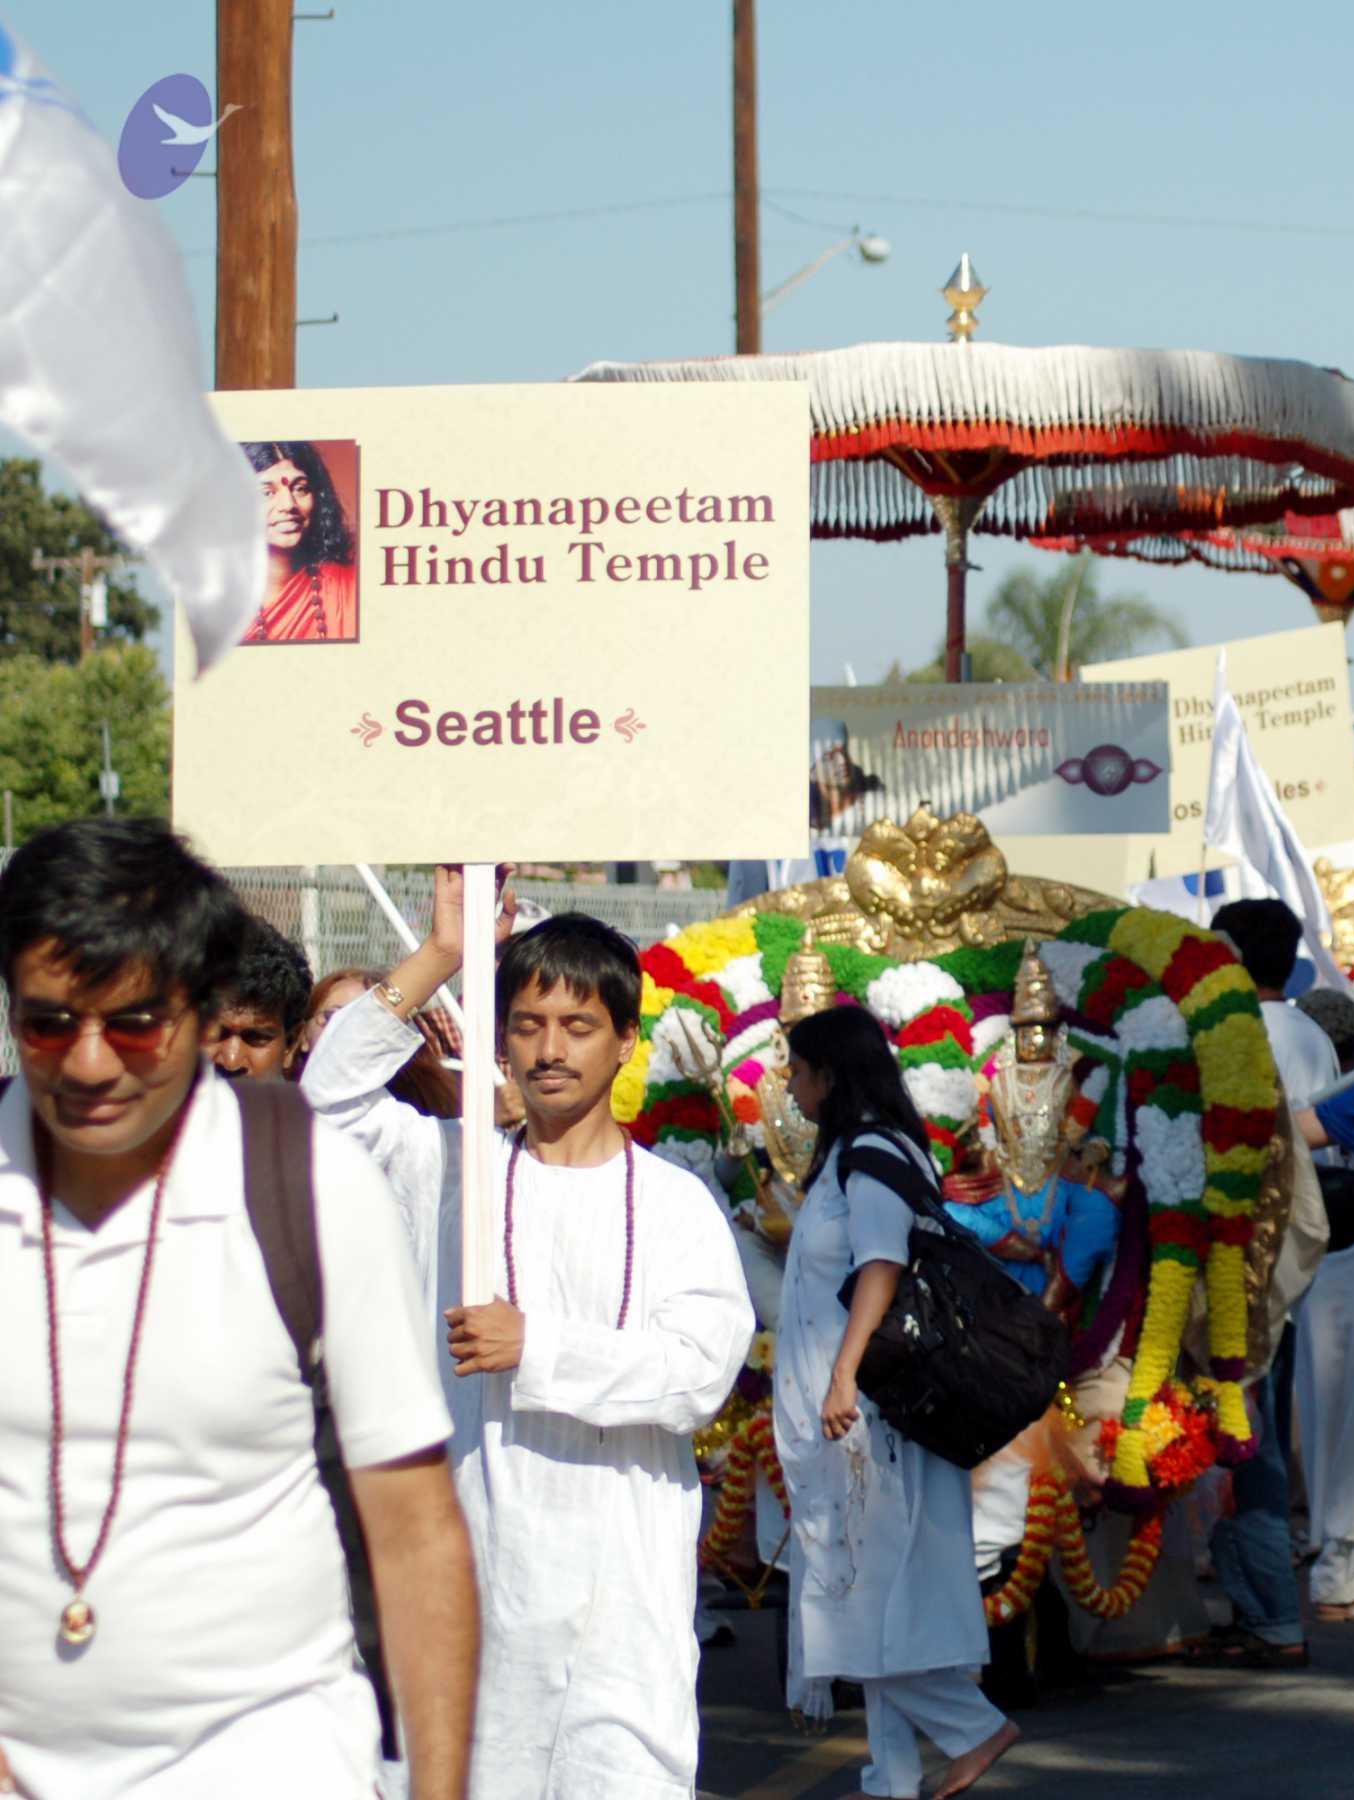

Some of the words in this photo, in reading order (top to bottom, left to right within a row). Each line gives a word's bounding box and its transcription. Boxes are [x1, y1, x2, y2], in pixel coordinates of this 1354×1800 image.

[373, 486, 776, 537] Dhyanapeetam
[379, 542, 547, 586] Hindu
[567, 539, 770, 591] Temple
[1174, 676, 1337, 719] Dhynapeetam
[1256, 700, 1337, 731] Temple
[394, 696, 601, 748] Seattle
[892, 716, 1051, 752] Anandeshwara
